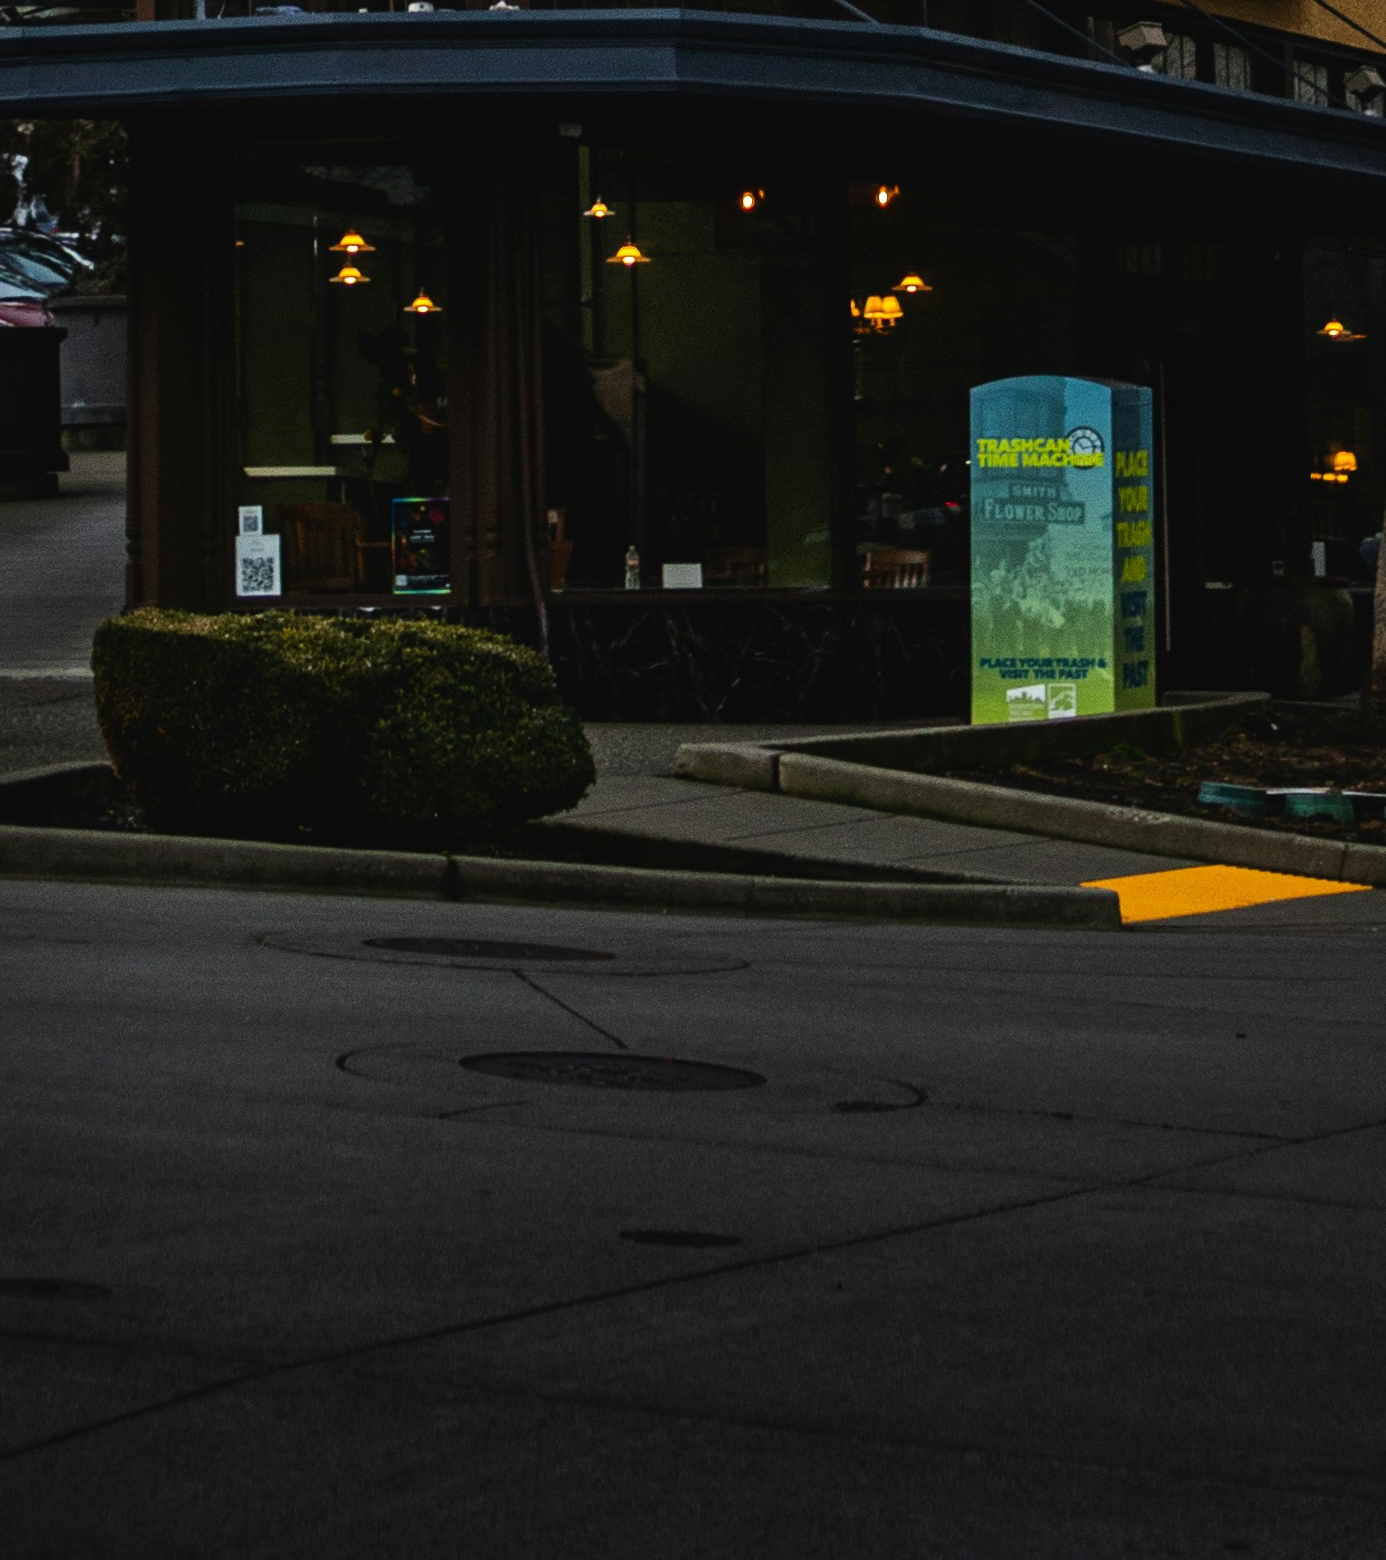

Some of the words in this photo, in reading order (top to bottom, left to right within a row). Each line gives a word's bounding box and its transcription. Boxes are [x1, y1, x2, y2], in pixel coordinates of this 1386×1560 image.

[977, 438, 1070, 453] TRASHCAN
[977, 453, 1019, 468] TIME
[1022, 452, 1105, 468] MACHINE
[1115, 450, 1149, 477] PLACE
[1012, 484, 1056, 499] SMITH
[1118, 486, 1149, 513] YOUR
[980, 657, 1017, 669] PLACE
[1020, 657, 1054, 669] YOUR
[1055, 657, 1095, 669] TRASH
[1098, 657, 1107, 669] &
[999, 669, 1030, 680] VISIT
[1033, 669, 1056, 679] THE
[1058, 669, 1088, 679] PAST
